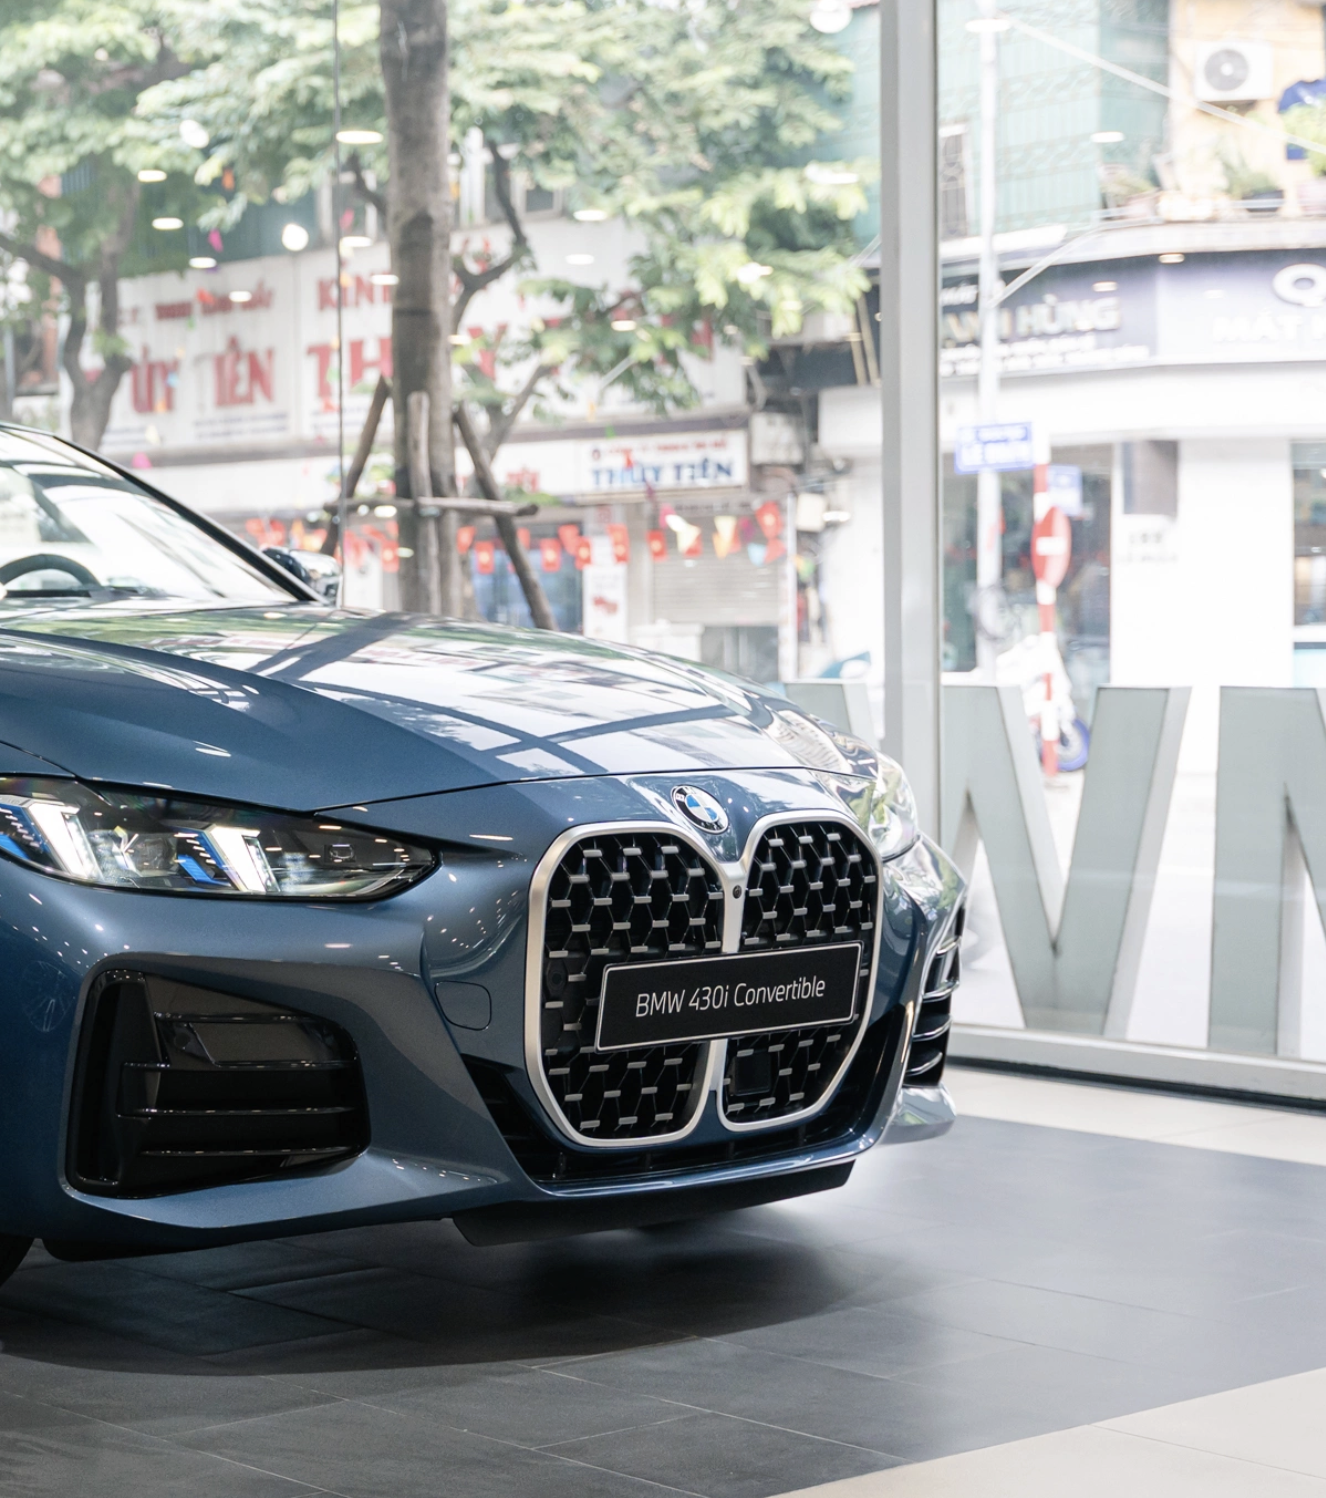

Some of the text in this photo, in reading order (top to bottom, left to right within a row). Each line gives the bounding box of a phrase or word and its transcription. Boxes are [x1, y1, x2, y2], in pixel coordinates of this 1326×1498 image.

[635, 975, 826, 1018] BMW 430i Convertible
